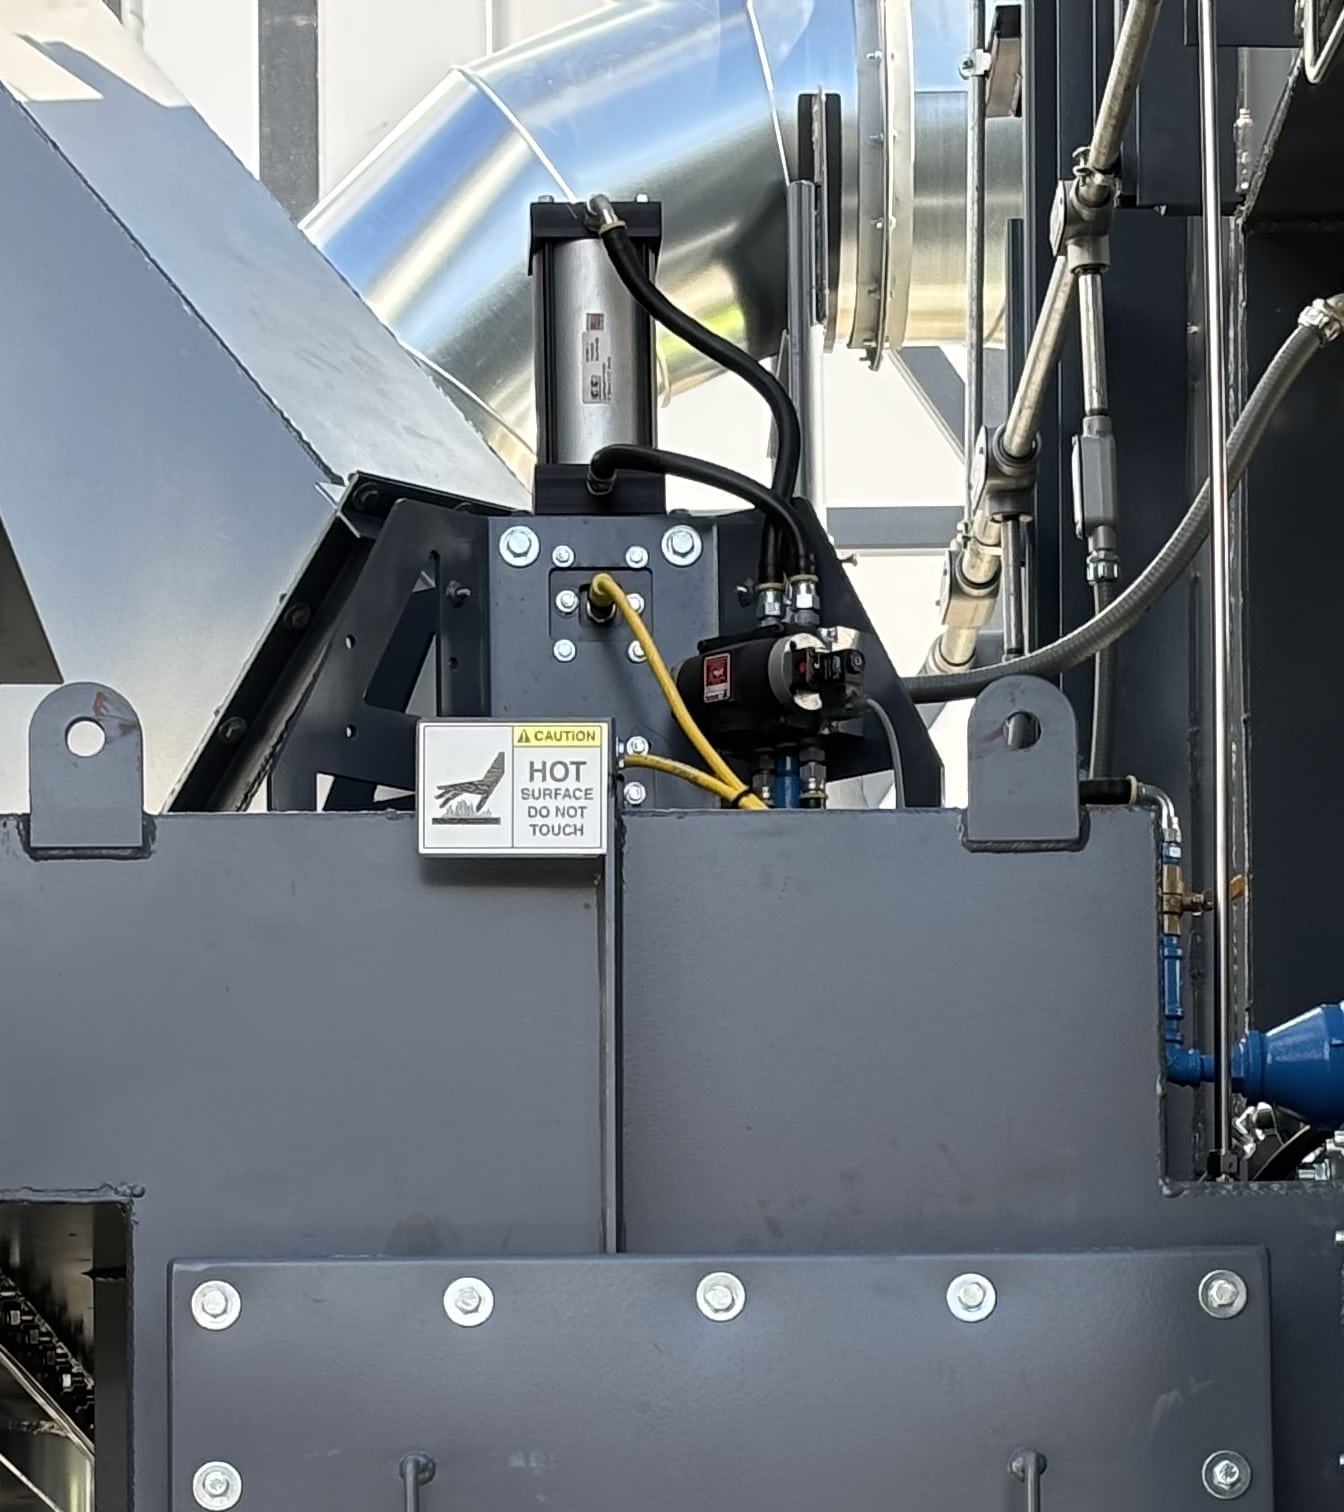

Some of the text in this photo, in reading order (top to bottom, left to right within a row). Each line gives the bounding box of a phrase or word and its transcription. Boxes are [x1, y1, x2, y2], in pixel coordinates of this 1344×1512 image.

[534, 731, 595, 742] CAUTION
[529, 760, 587, 783] HOT
[521, 788, 594, 800] SURFACE
[528, 806, 587, 819] DO NOT
[529, 824, 584, 836] TOUCH
